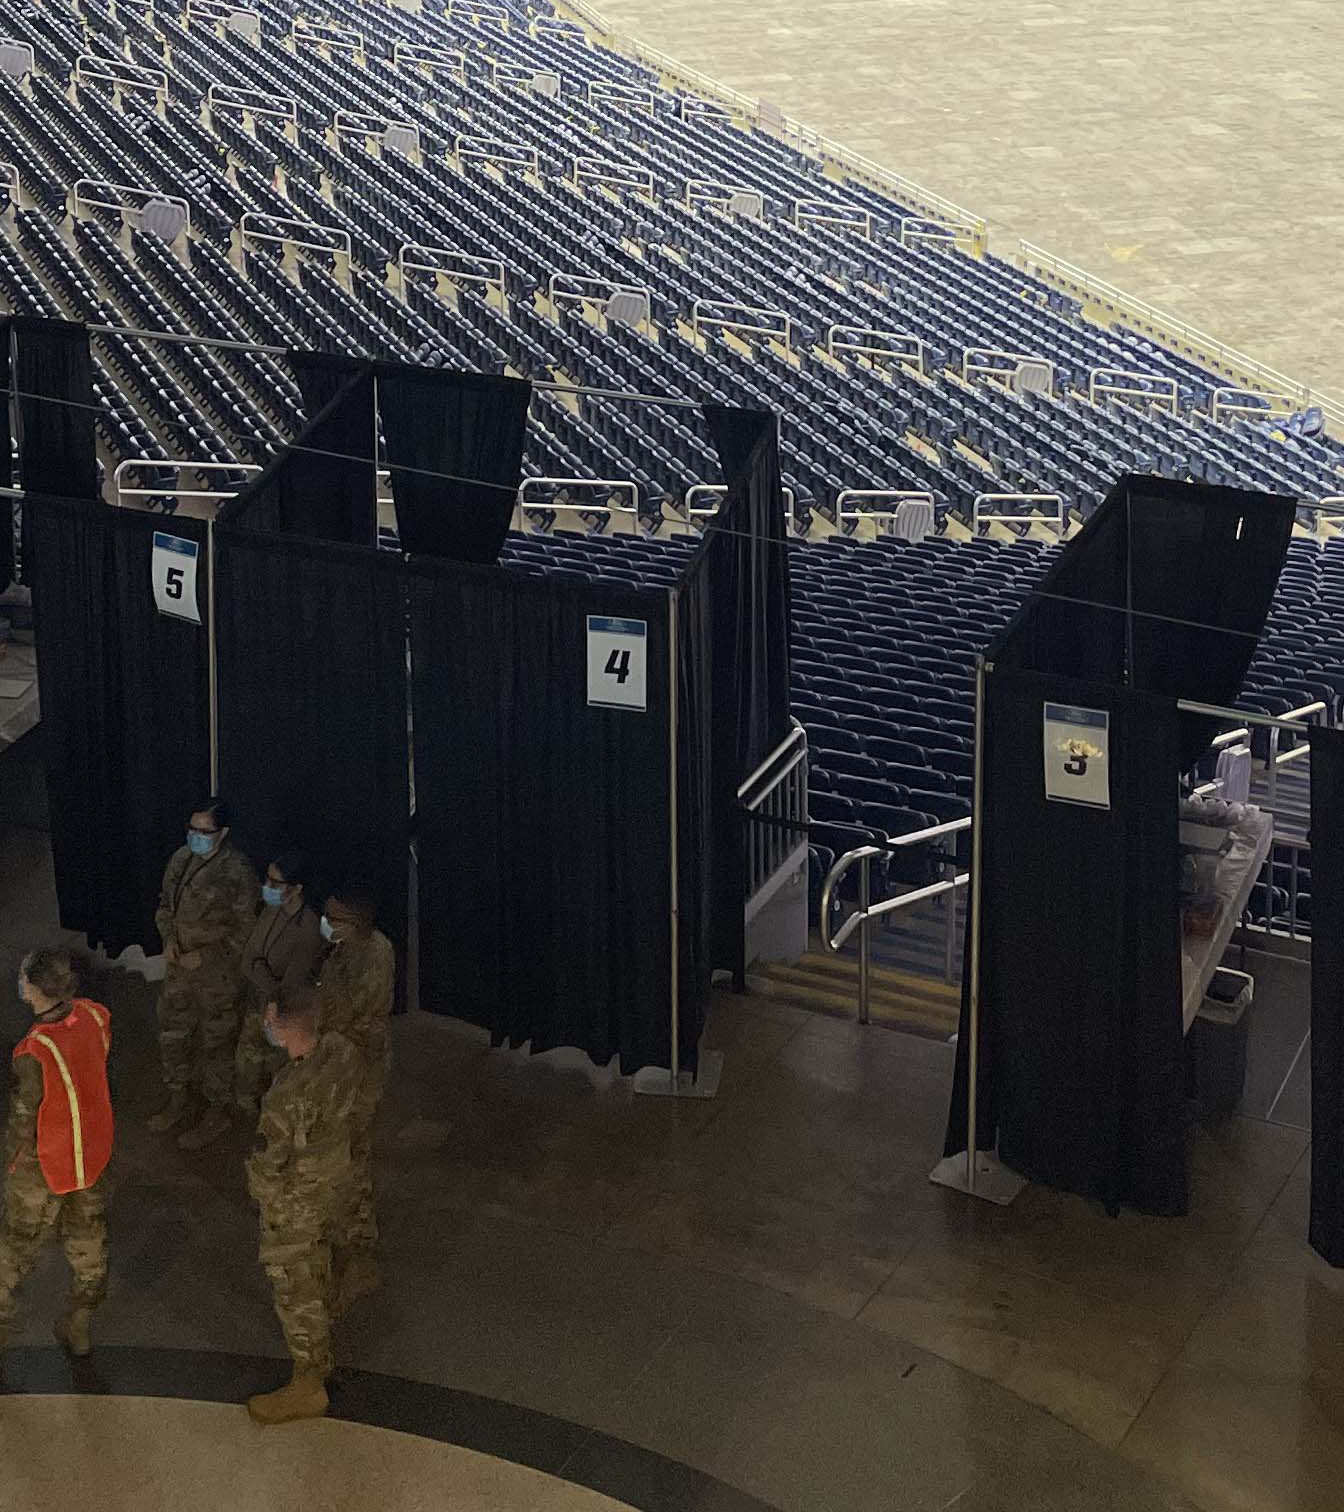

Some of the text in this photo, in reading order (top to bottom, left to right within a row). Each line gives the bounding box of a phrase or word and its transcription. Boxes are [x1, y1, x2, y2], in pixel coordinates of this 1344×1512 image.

[165, 567, 185, 599] 5
[604, 649, 631, 684] 4
[1063, 745, 1089, 776] 3
